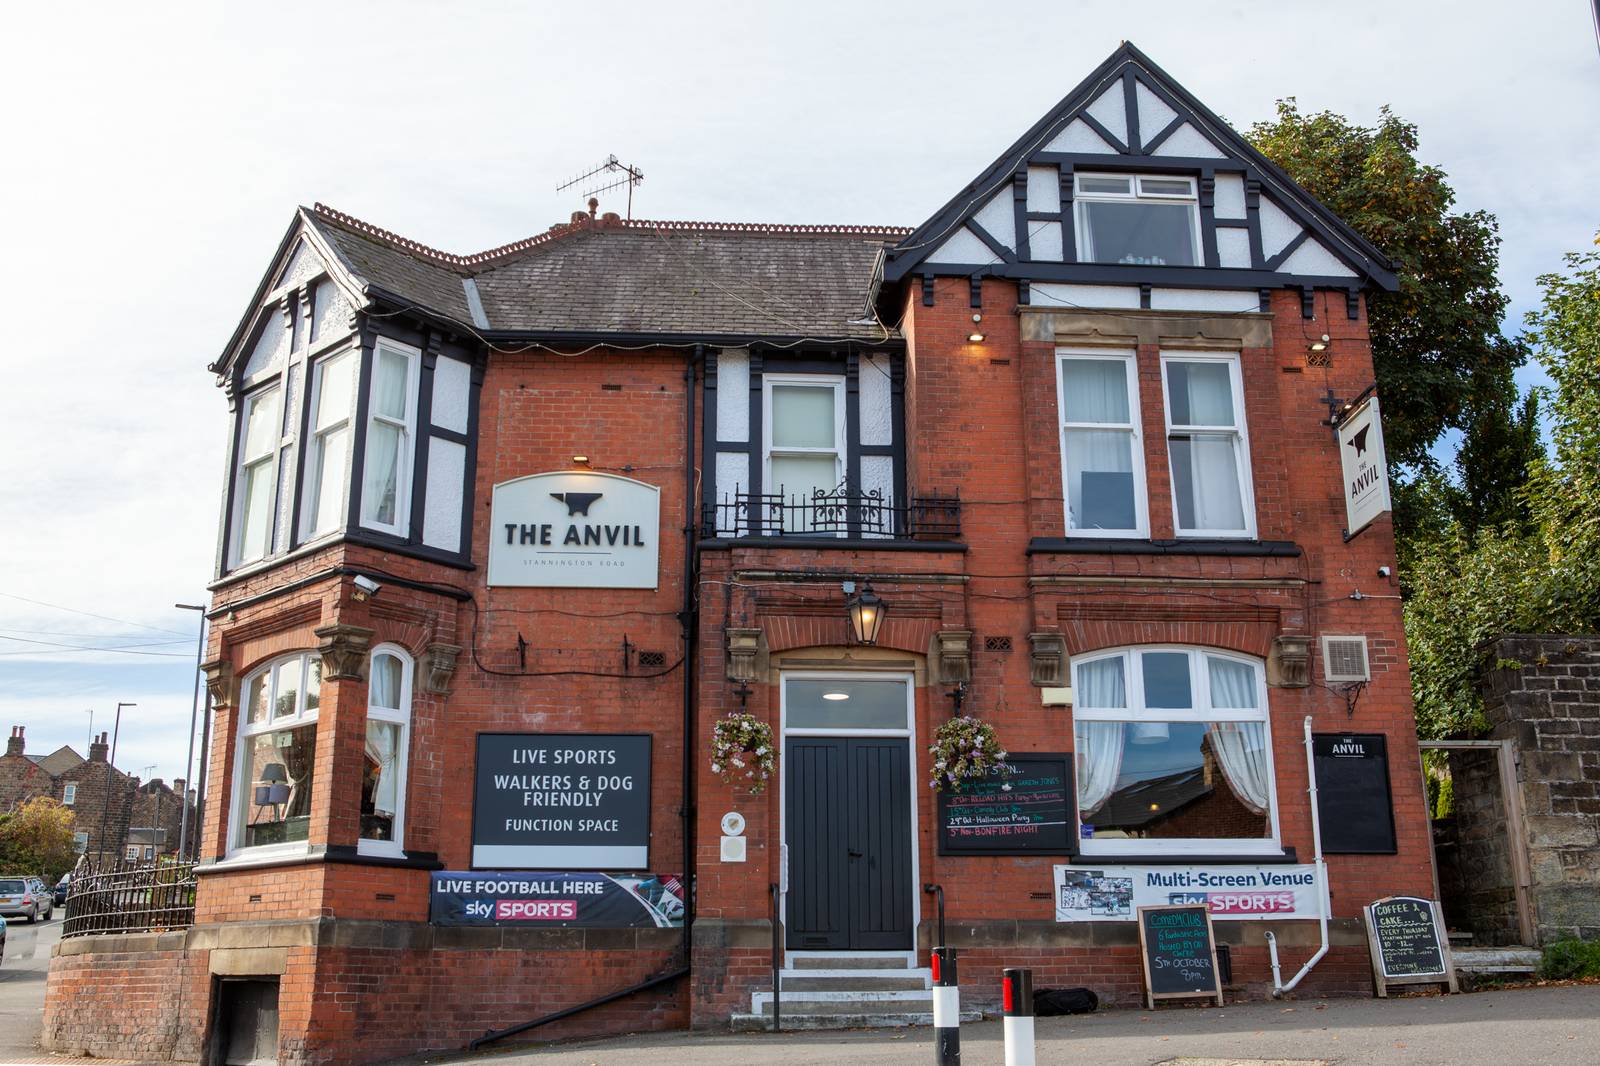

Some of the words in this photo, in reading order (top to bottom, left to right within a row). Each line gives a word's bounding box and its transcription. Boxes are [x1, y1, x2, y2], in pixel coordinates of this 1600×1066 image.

[1358, 461, 1367, 472] THE
[1352, 465, 1379, 499] ANVIL
[504, 523, 553, 545] THE
[563, 524, 645, 546] ANVIL
[1332, 744, 1366, 754] ANVIL
[512, 749, 547, 764] LIVE
[553, 749, 617, 765] SPORTS
[494, 774, 572, 790] WALKERS
[578, 775, 591, 790] &
[597, 775, 633, 791] DOG
[523, 792, 603, 807] FRIENDLY
[505, 819, 573, 832] FUNCTION
[578, 819, 619, 832] SPACE
[976, 815, 1010, 823] Halloween
[975, 826, 1011, 836] BONFIRE
[1014, 825, 1039, 834] NIGHT
[437, 880, 472, 894] LIVE
[475, 880, 560, 895] FOOTBALL
[562, 881, 604, 895] HERE
[1146, 872, 1257, 888] Multi-Screen
[1259, 872, 1313, 886] Venue
[465, 900, 494, 918] sky
[499, 902, 573, 917] SPORTS
[1208, 894, 1292, 911] SPORTS
[1377, 903, 1409, 916] COFFEE
[1380, 928, 1400, 936] EVERY
[1402, 927, 1429, 935] THURSDAY
[1173, 958, 1212, 969] OCTOBER
